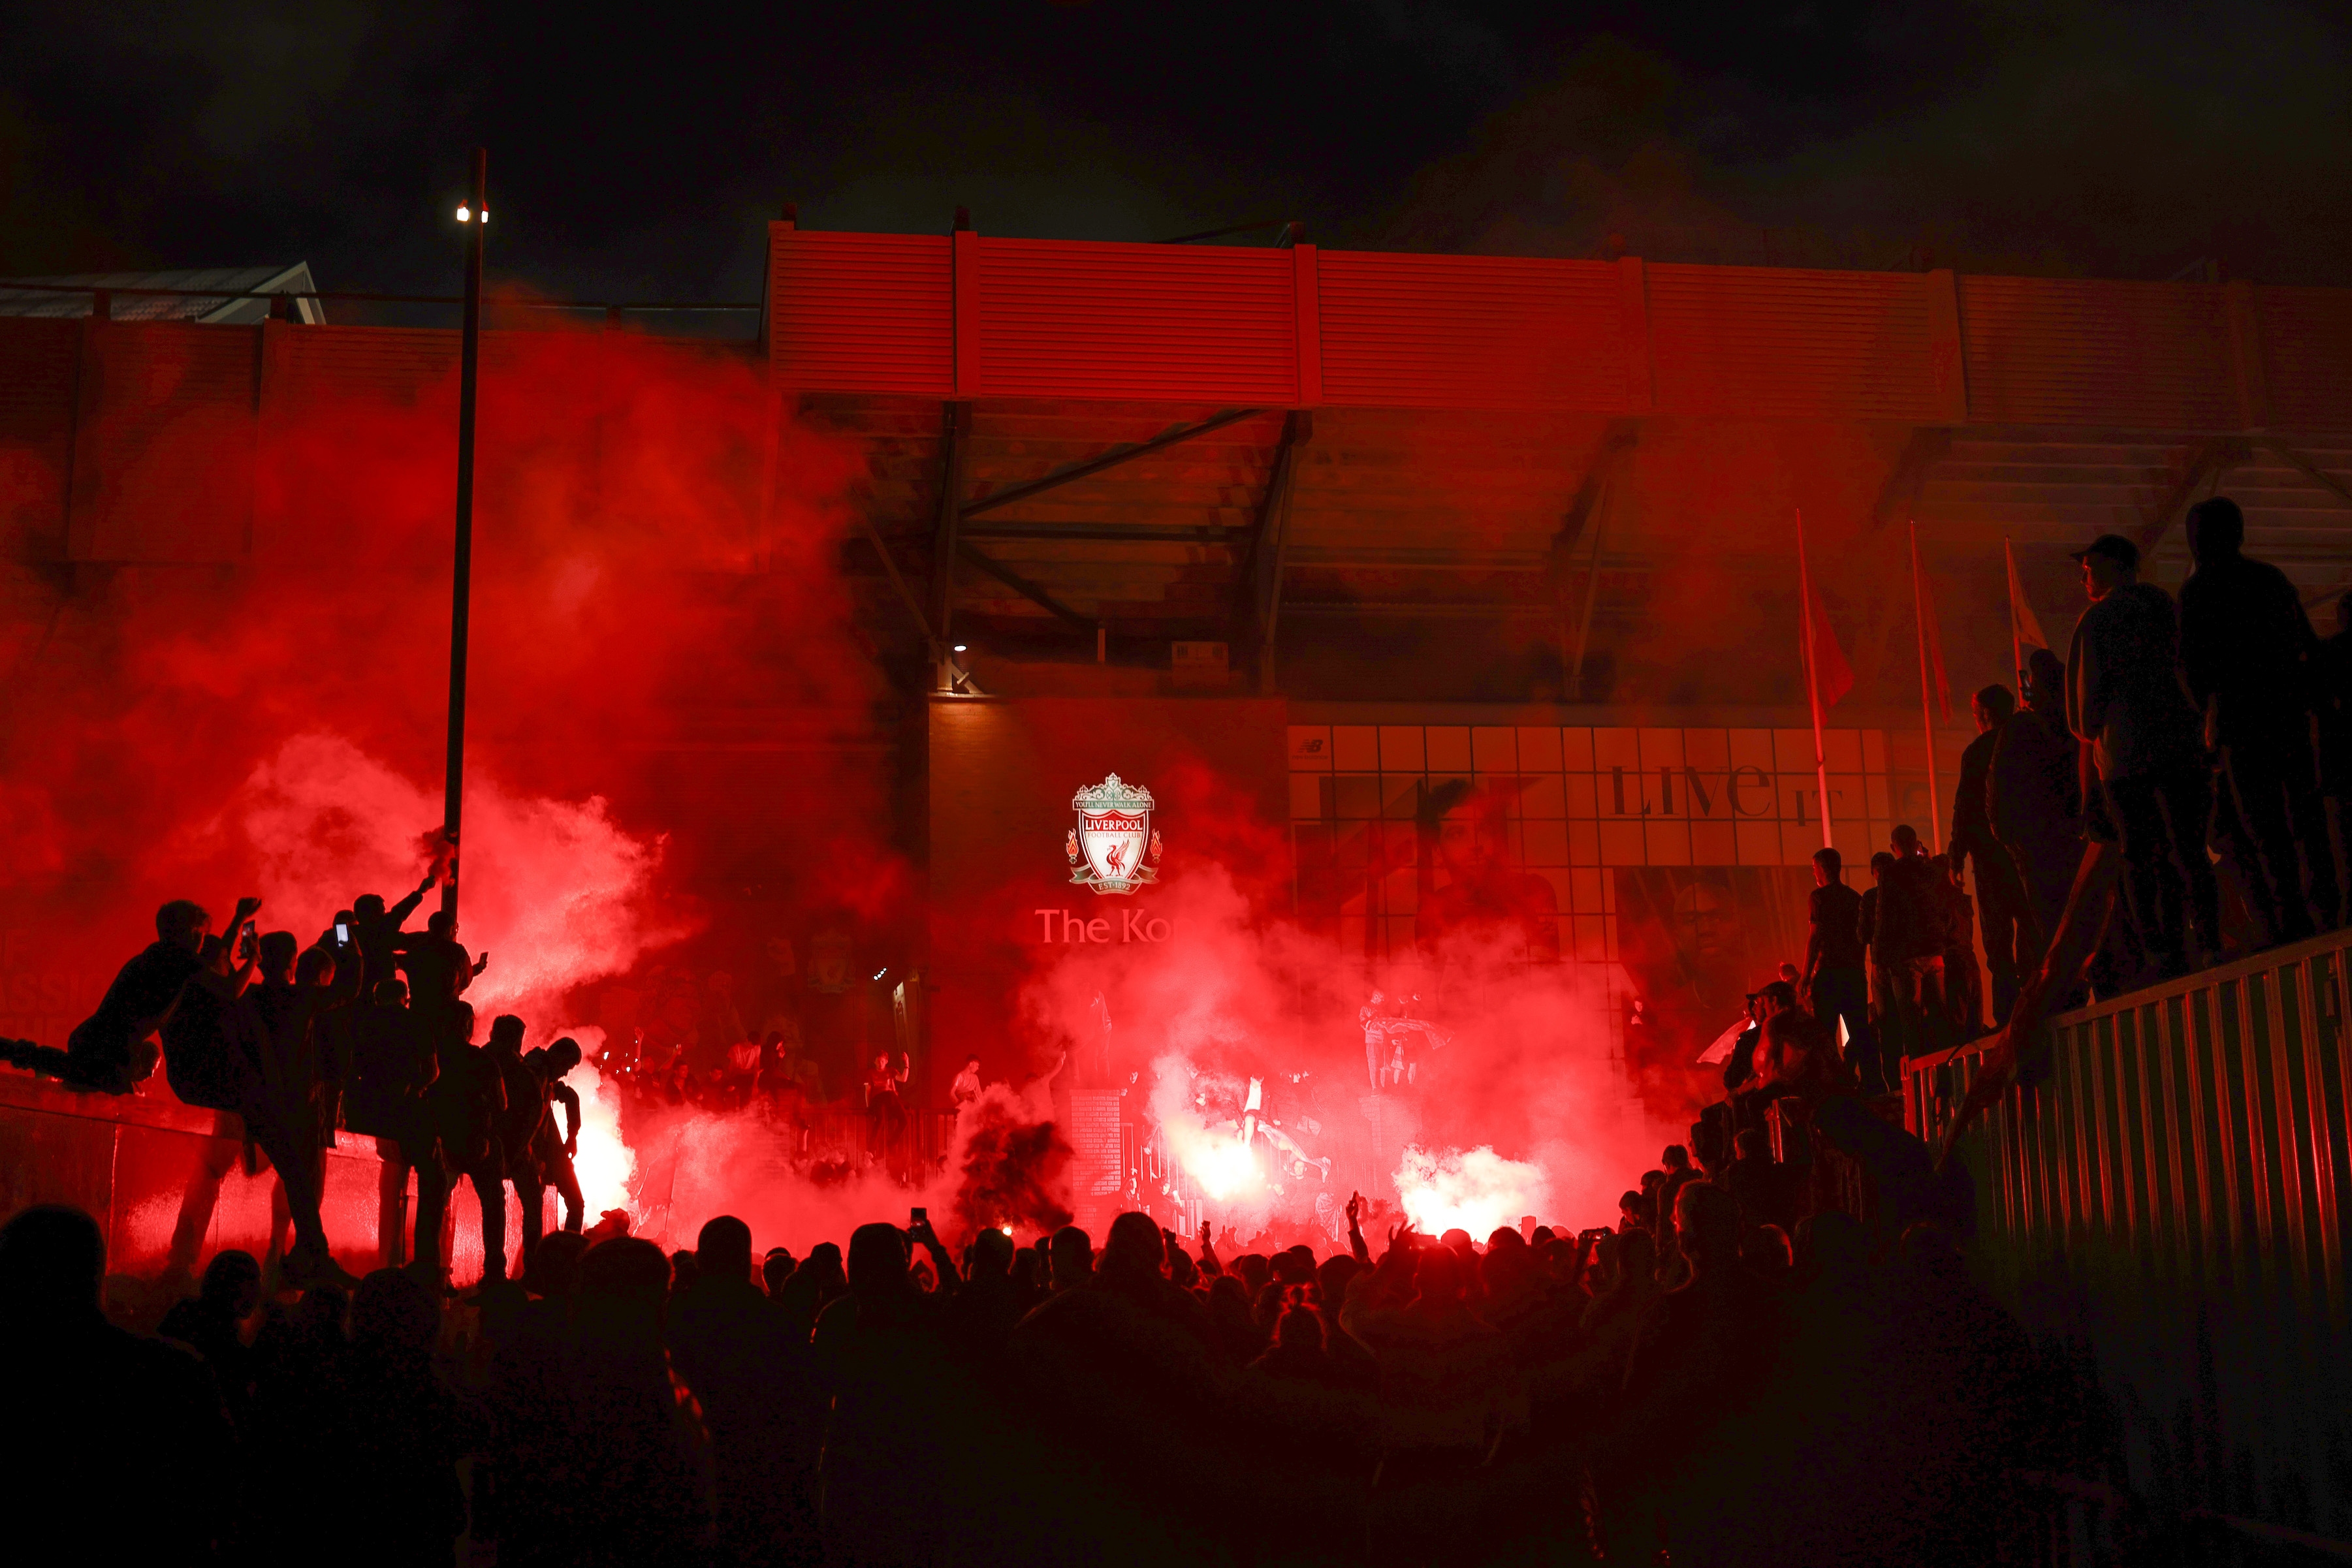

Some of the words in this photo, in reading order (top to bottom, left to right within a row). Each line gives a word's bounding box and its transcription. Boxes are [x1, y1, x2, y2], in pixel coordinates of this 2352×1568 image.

[1085, 819, 1143, 830] LIVERPOOL
[1034, 909, 1110, 943] The
[1122, 909, 1196, 946] Ko
